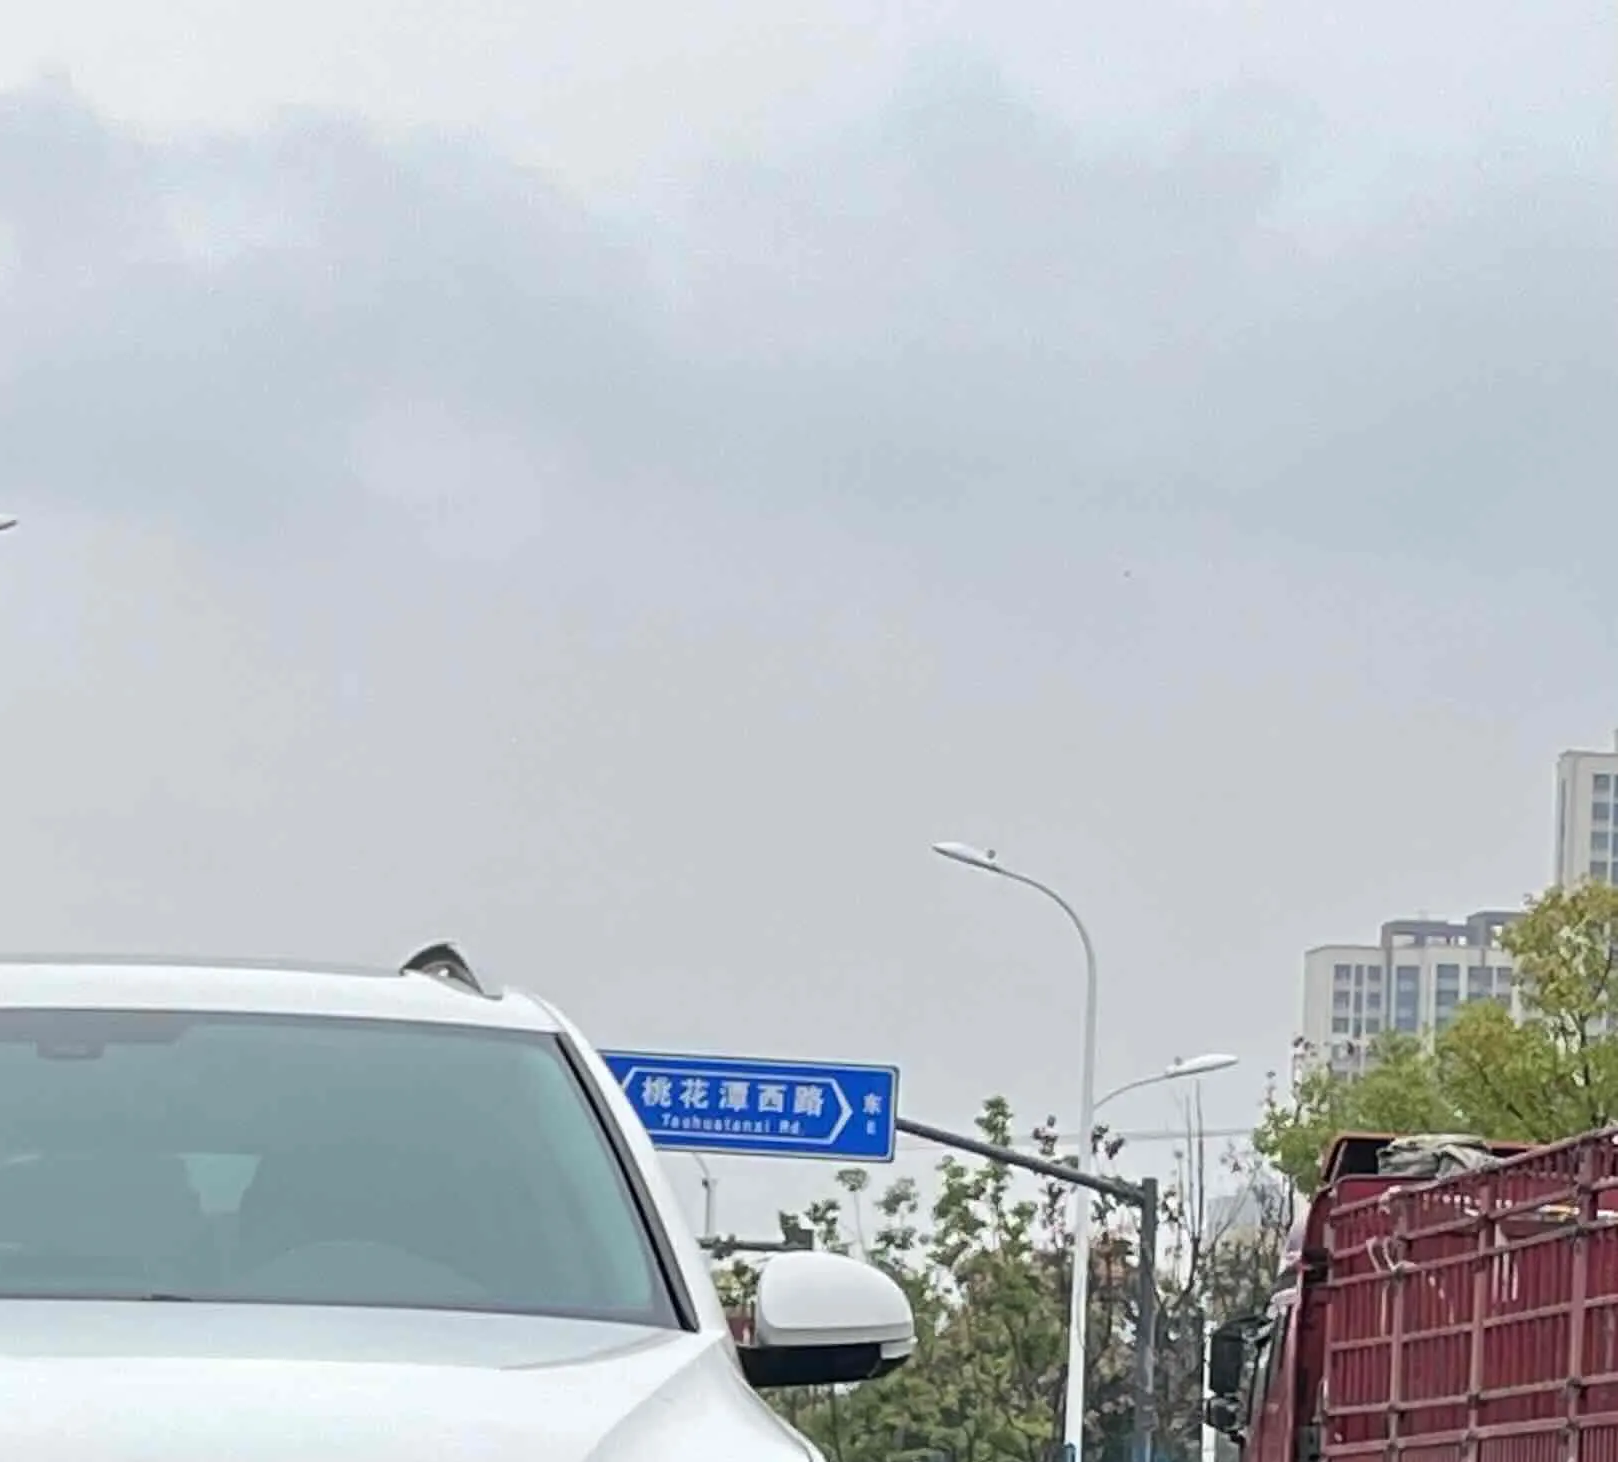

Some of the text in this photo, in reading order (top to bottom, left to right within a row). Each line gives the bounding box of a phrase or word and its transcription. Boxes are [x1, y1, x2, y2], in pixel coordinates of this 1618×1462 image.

[642, 1076, 825, 1118] 桃花潭西路
